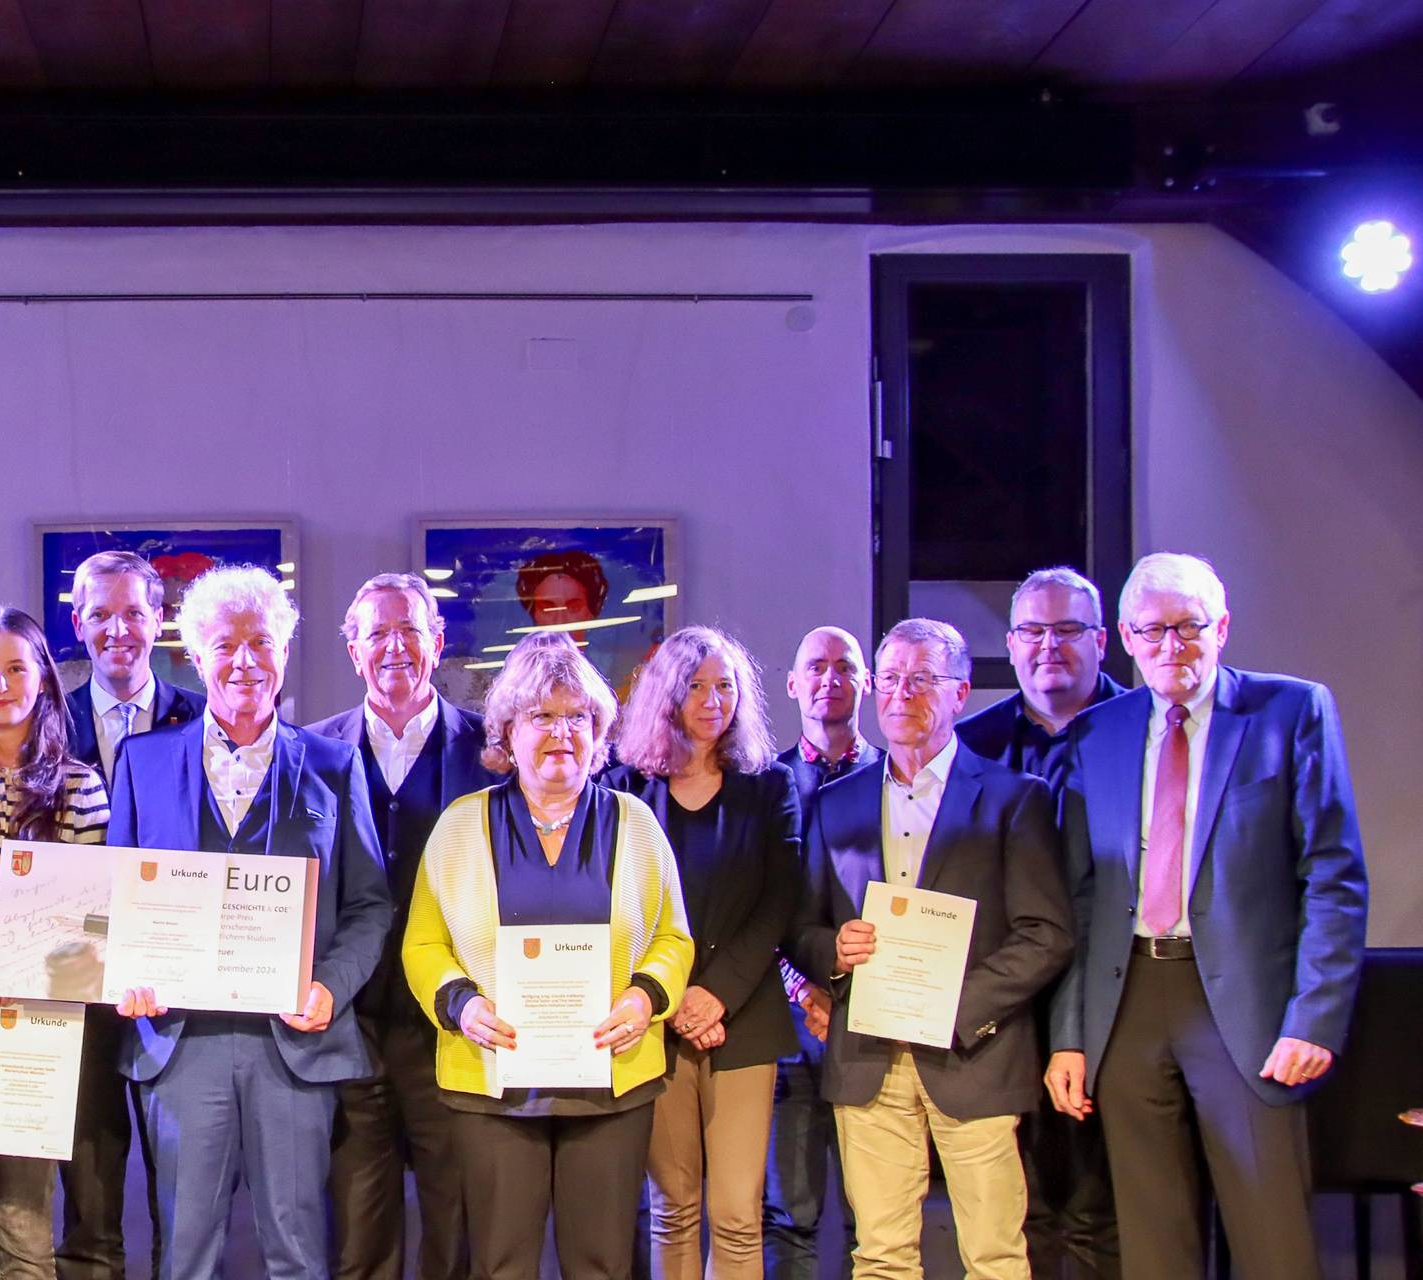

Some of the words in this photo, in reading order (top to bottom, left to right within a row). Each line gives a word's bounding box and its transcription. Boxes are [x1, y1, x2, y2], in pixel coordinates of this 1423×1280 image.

[171, 868, 209, 878] Urkunde
[227, 866, 291, 892] Euro
[222, 903, 265, 912] GESCHICHTE
[921, 906, 957, 920] Urkunde
[555, 943, 593, 952] Urkunde
[217, 965, 254, 973] ovember
[256, 966, 277, 974] 2024
[31, 1016, 67, 1028] Urkunde
